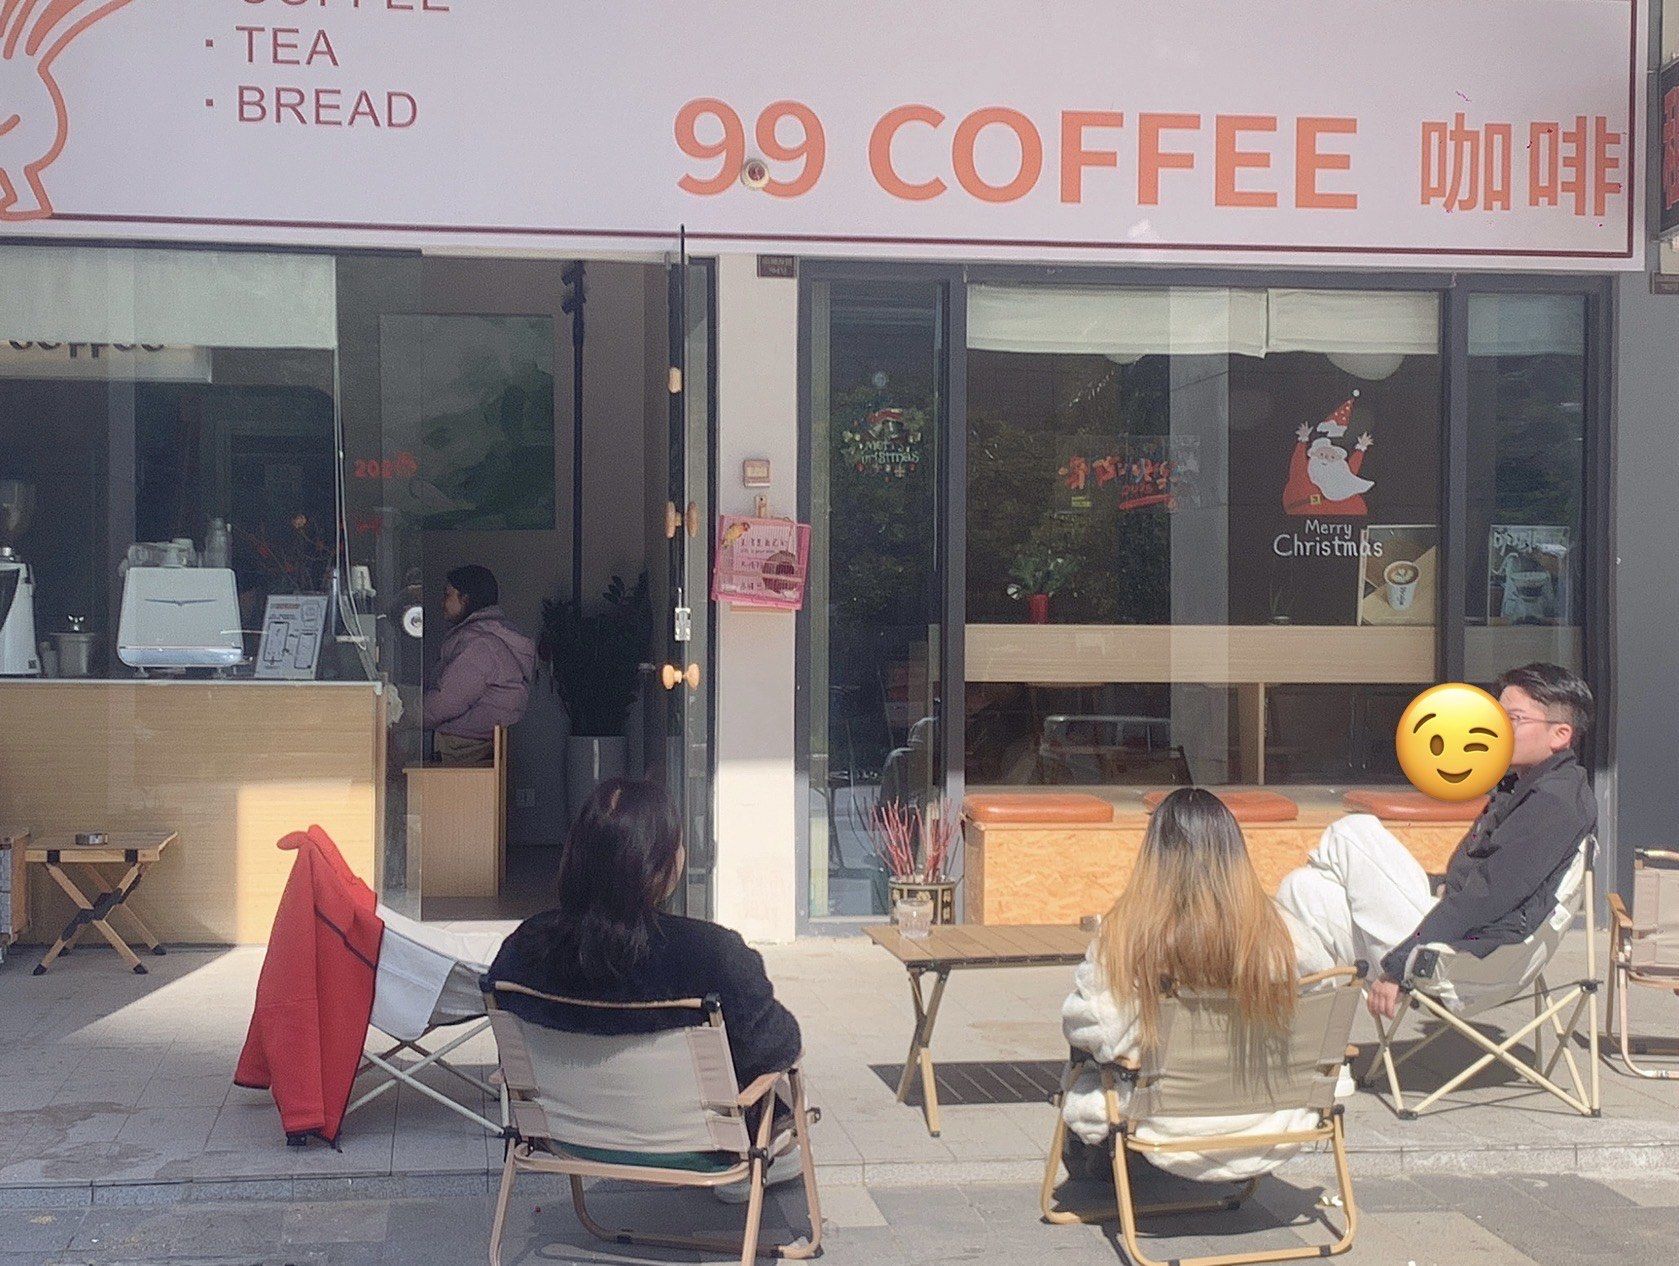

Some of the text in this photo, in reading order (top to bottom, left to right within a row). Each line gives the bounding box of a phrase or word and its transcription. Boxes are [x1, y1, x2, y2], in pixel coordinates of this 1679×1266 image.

[235, 25, 340, 67] TEA
[237, 85, 418, 128] BREAD
[674, 97, 826, 200] 99
[869, 103, 1358, 211] COFFEE
[1420, 112, 1622, 216] 咖啡
[1273, 533, 1384, 557] Christmas
[1305, 519, 1352, 539] Merry
